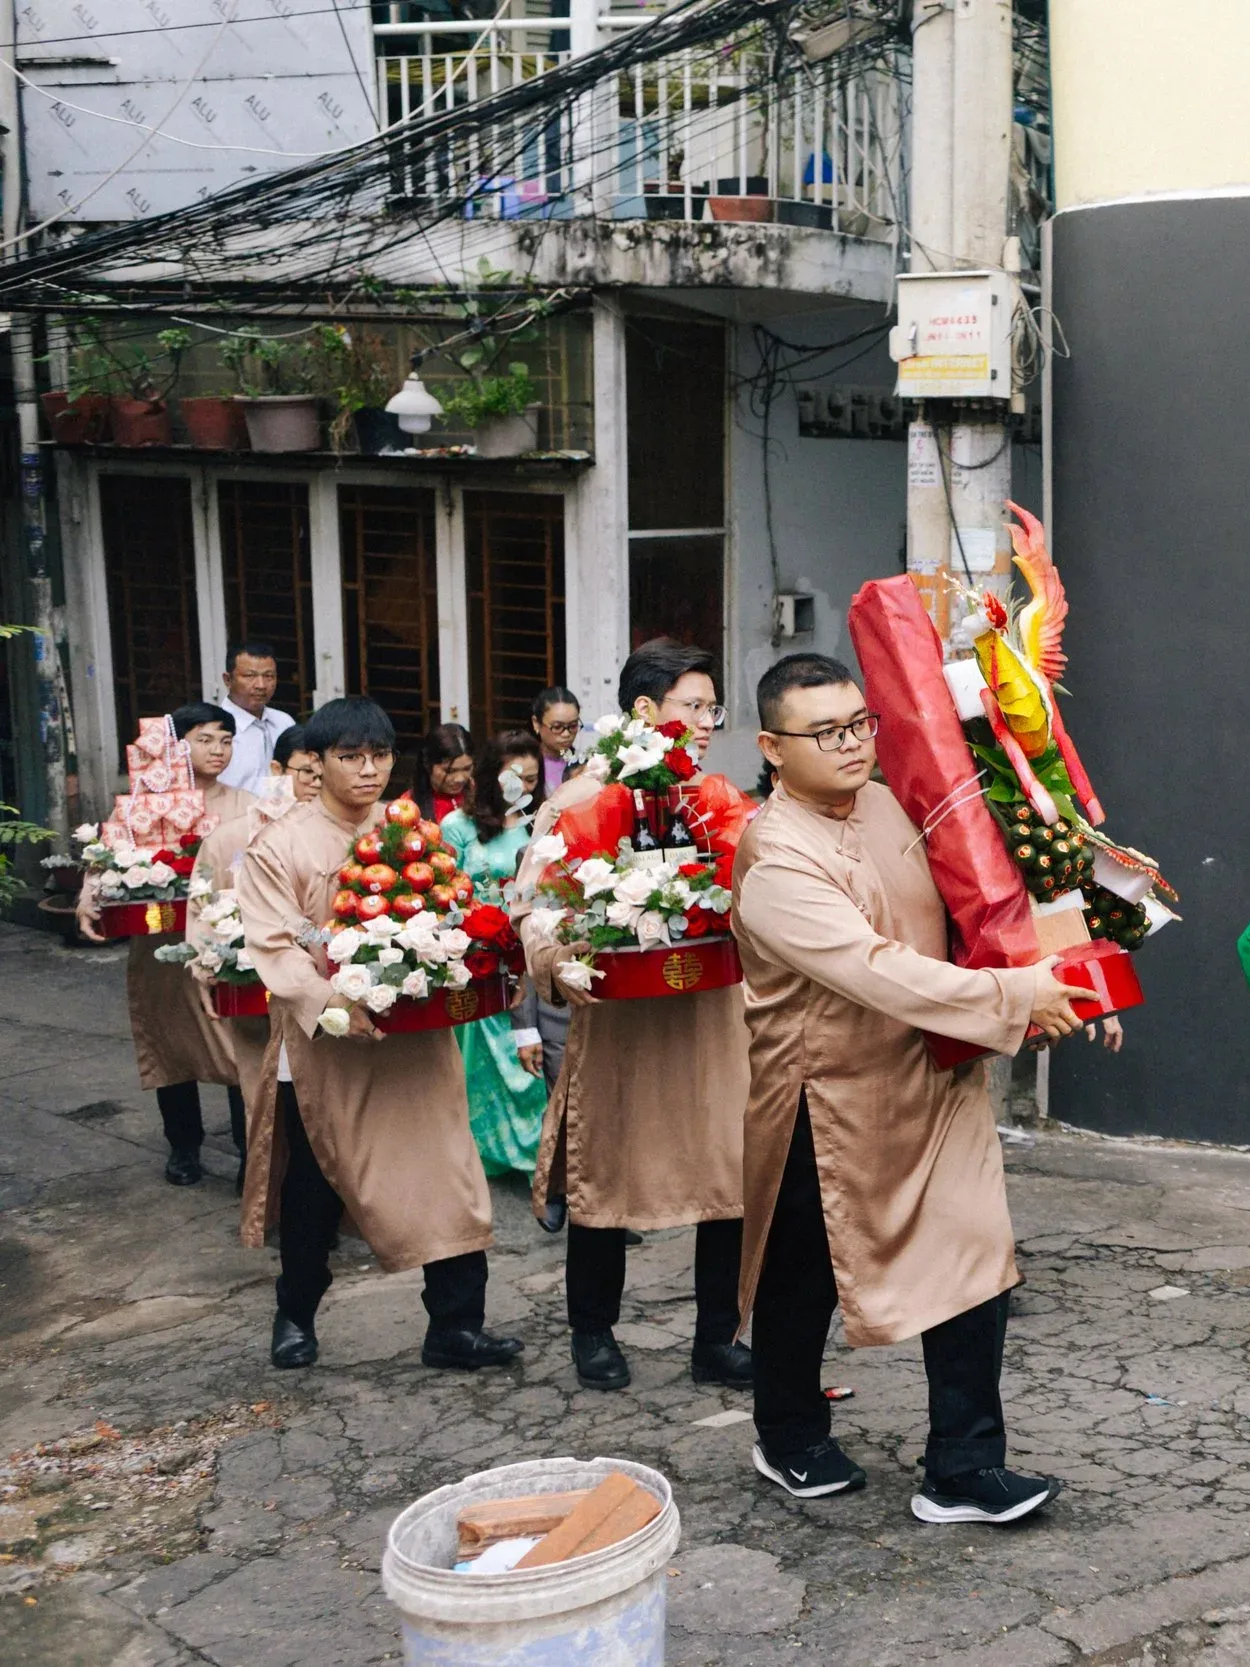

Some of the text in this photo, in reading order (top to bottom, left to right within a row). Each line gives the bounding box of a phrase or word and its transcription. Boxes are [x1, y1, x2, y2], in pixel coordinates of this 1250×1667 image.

[22, 6, 46, 32] ALU
[72, 4, 99, 30] ALU
[146, 1, 172, 27] ALU
[51, 101, 77, 128] ALU
[120, 99, 146, 125] ALU
[192, 97, 218, 123] ALU
[245, 94, 271, 121] ALU
[318, 92, 344, 119] ALU
[126, 187, 151, 214] ALU
